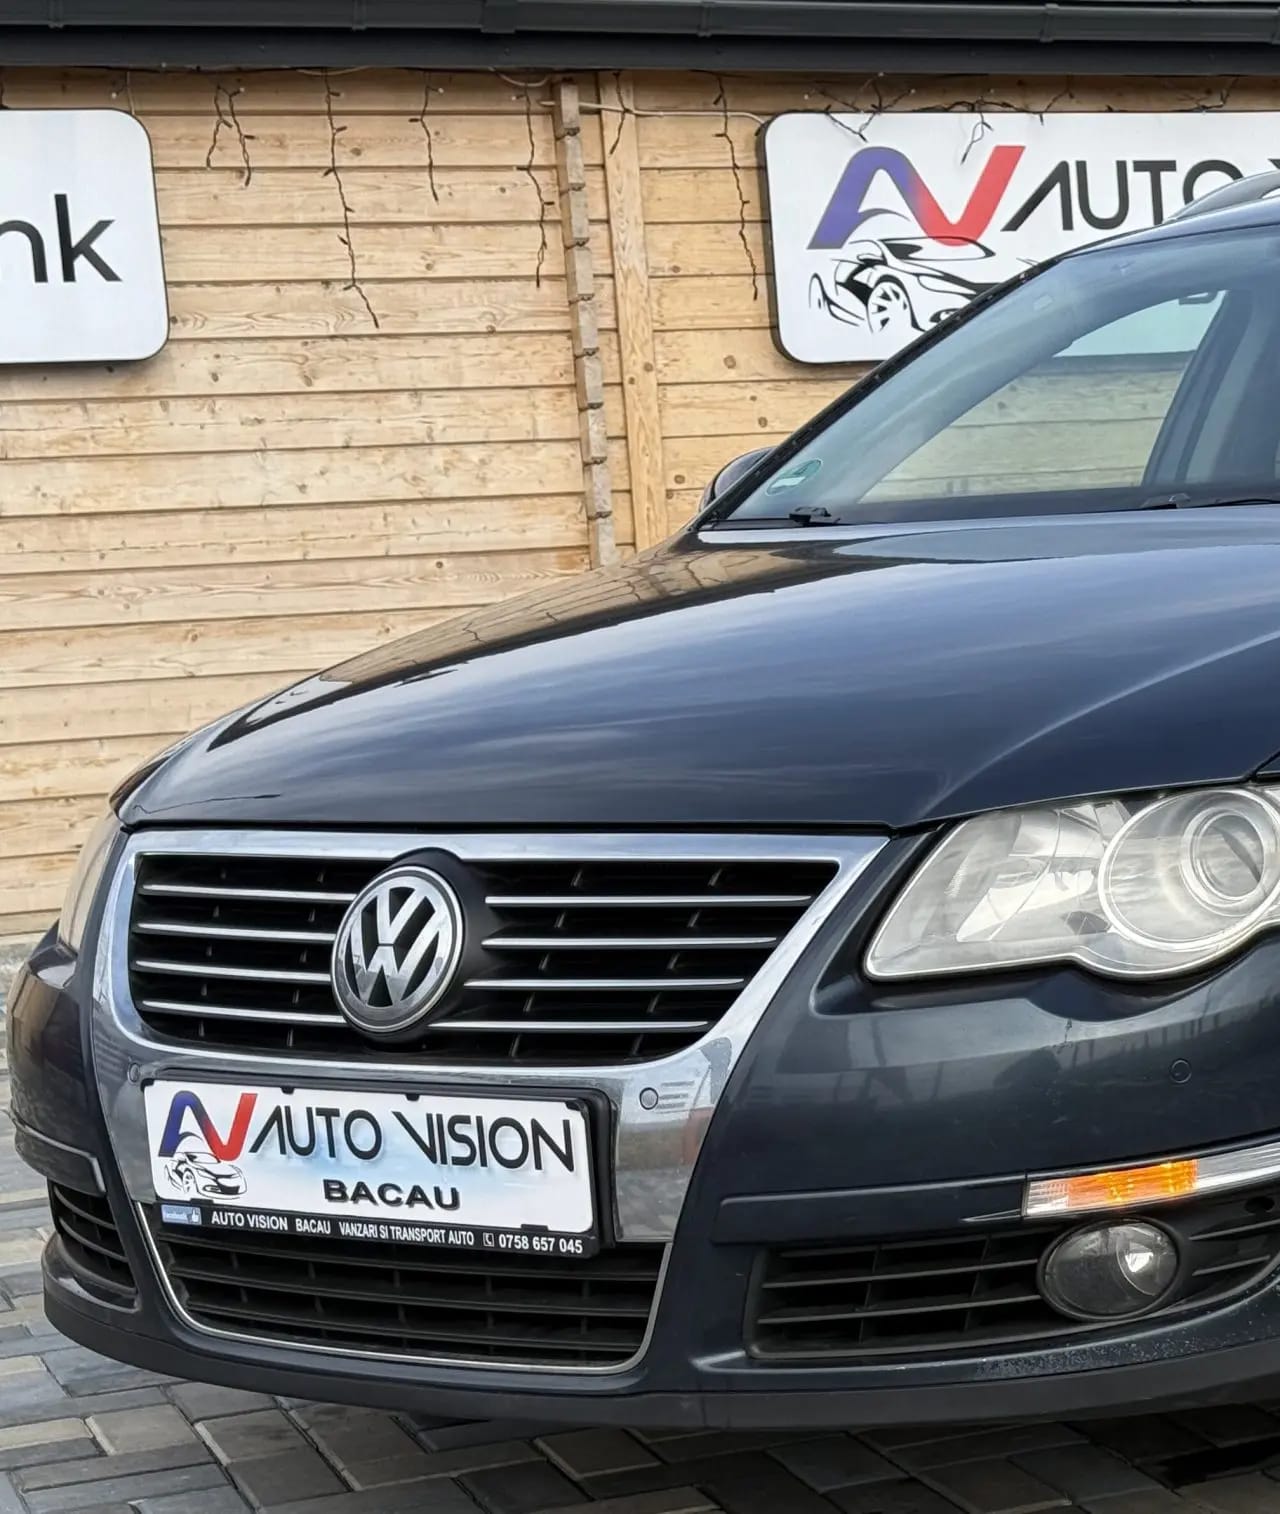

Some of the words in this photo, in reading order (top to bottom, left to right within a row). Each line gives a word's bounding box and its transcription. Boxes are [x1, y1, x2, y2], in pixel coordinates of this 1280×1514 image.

[0, 194, 123, 283] nk
[248, 1104, 383, 1161] AUTO
[391, 1110, 575, 1173] VISION
[323, 1178, 461, 1211] BACAU
[211, 1210, 245, 1228] AUTO
[246, 1214, 288, 1232] VISION
[295, 1218, 331, 1235] BACAU
[338, 1221, 379, 1239] VANZARI
[379, 1225, 389, 1240] SI
[389, 1226, 447, 1244] TRANSPORT
[448, 1230, 475, 1246] AUTO
[499, 1234, 530, 1251] 0758
[532, 1236, 555, 1252] 657
[559, 1239, 583, 1255] 045
